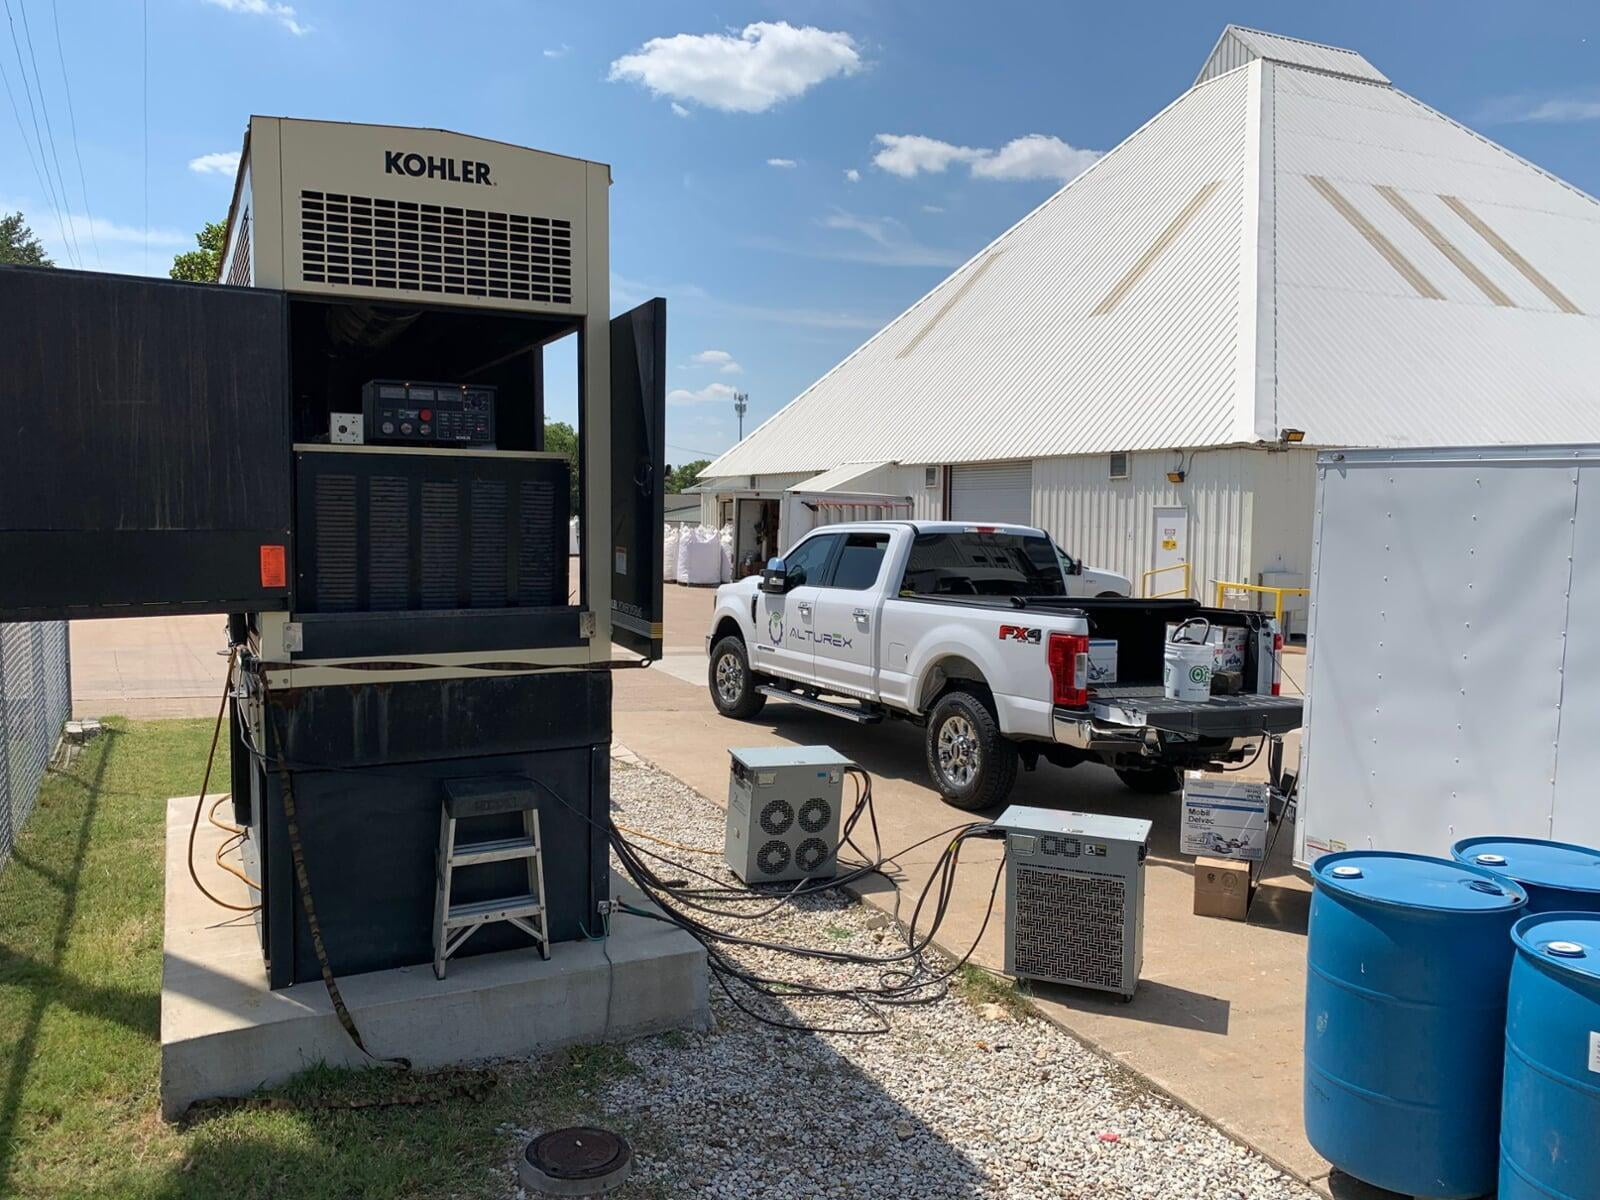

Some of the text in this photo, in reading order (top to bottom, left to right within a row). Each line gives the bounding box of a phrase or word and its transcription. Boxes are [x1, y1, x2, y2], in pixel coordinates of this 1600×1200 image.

[384, 150, 493, 186] KOHLER
[789, 627, 853, 649] ALTUREX
[998, 624, 1042, 642] FX4
[1188, 808, 1210, 816] Mobil
[1188, 815, 1215, 825] Delvac
